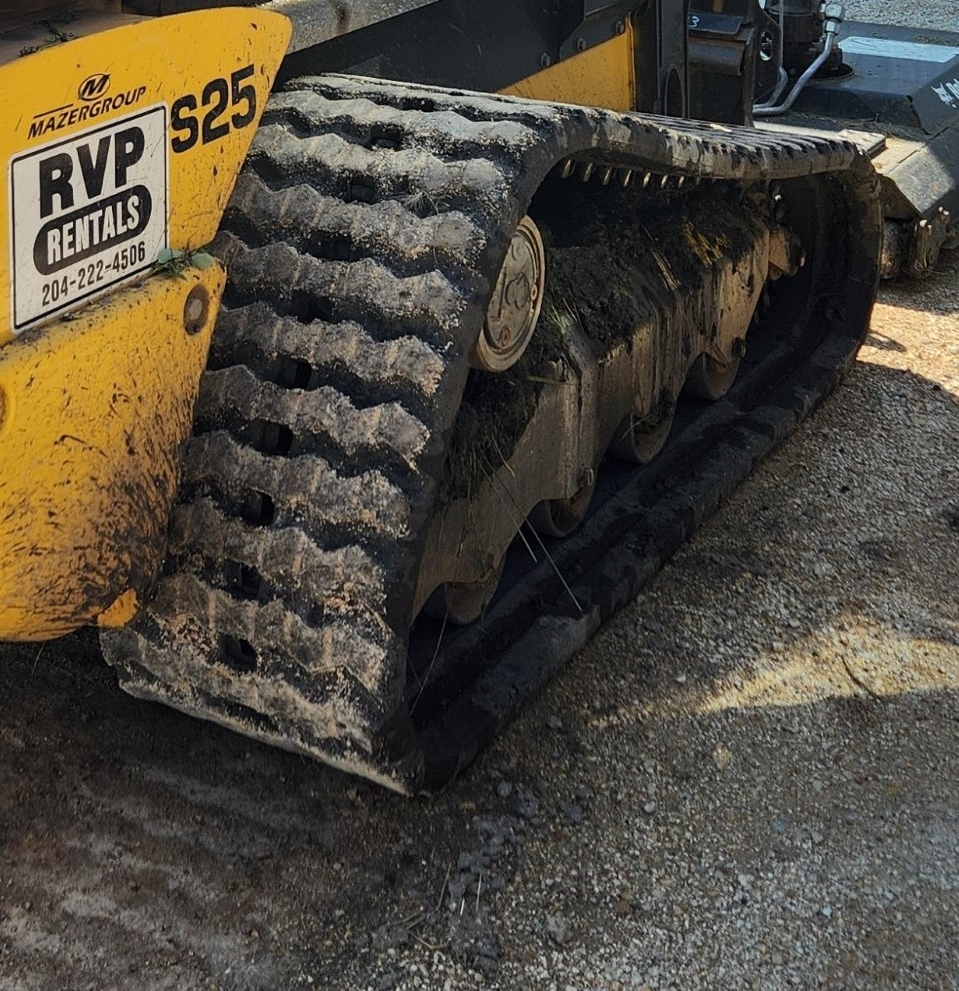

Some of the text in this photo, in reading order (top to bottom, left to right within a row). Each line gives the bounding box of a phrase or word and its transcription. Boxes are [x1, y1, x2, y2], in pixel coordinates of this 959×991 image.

[27, 85, 147, 140] MAZERGROUP
[170, 64, 257, 154] S25
[39, 126, 145, 219] RVP
[47, 195, 140, 266] RENTALS
[42, 241, 146, 307] 204-222-4506
